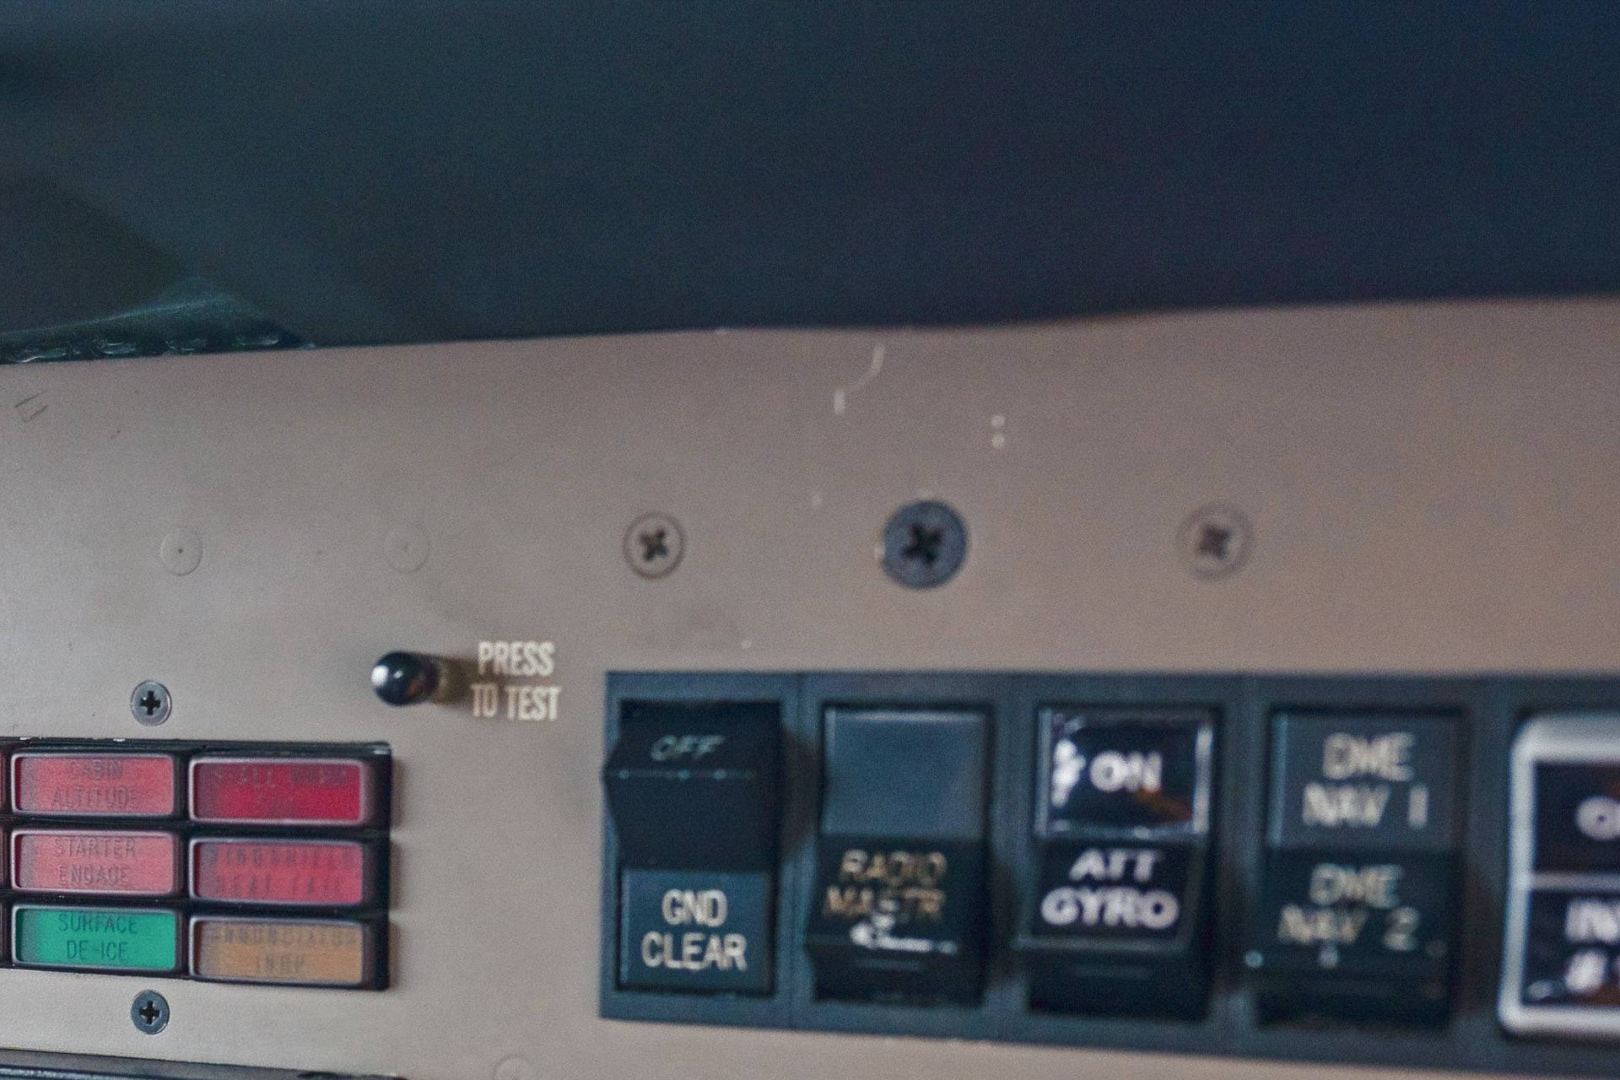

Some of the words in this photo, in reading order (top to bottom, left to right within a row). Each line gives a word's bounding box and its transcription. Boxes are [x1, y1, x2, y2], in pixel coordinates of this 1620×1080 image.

[479, 641, 555, 677] PRESS
[470, 683, 497, 718] TO
[506, 685, 562, 722] TEST
[650, 734, 724, 761] OFF
[1323, 731, 1416, 784] DME
[1089, 750, 1163, 793] ON
[54, 837, 137, 861] STARTER
[1069, 847, 1157, 883] ATT
[58, 864, 132, 887] ENGAGE
[58, 912, 139, 935] SURFACE
[661, 887, 729, 930] GND
[1040, 885, 1180, 930] GYRO
[66, 939, 129, 961] DE-ICE
[641, 932, 749, 972] CLEAR
